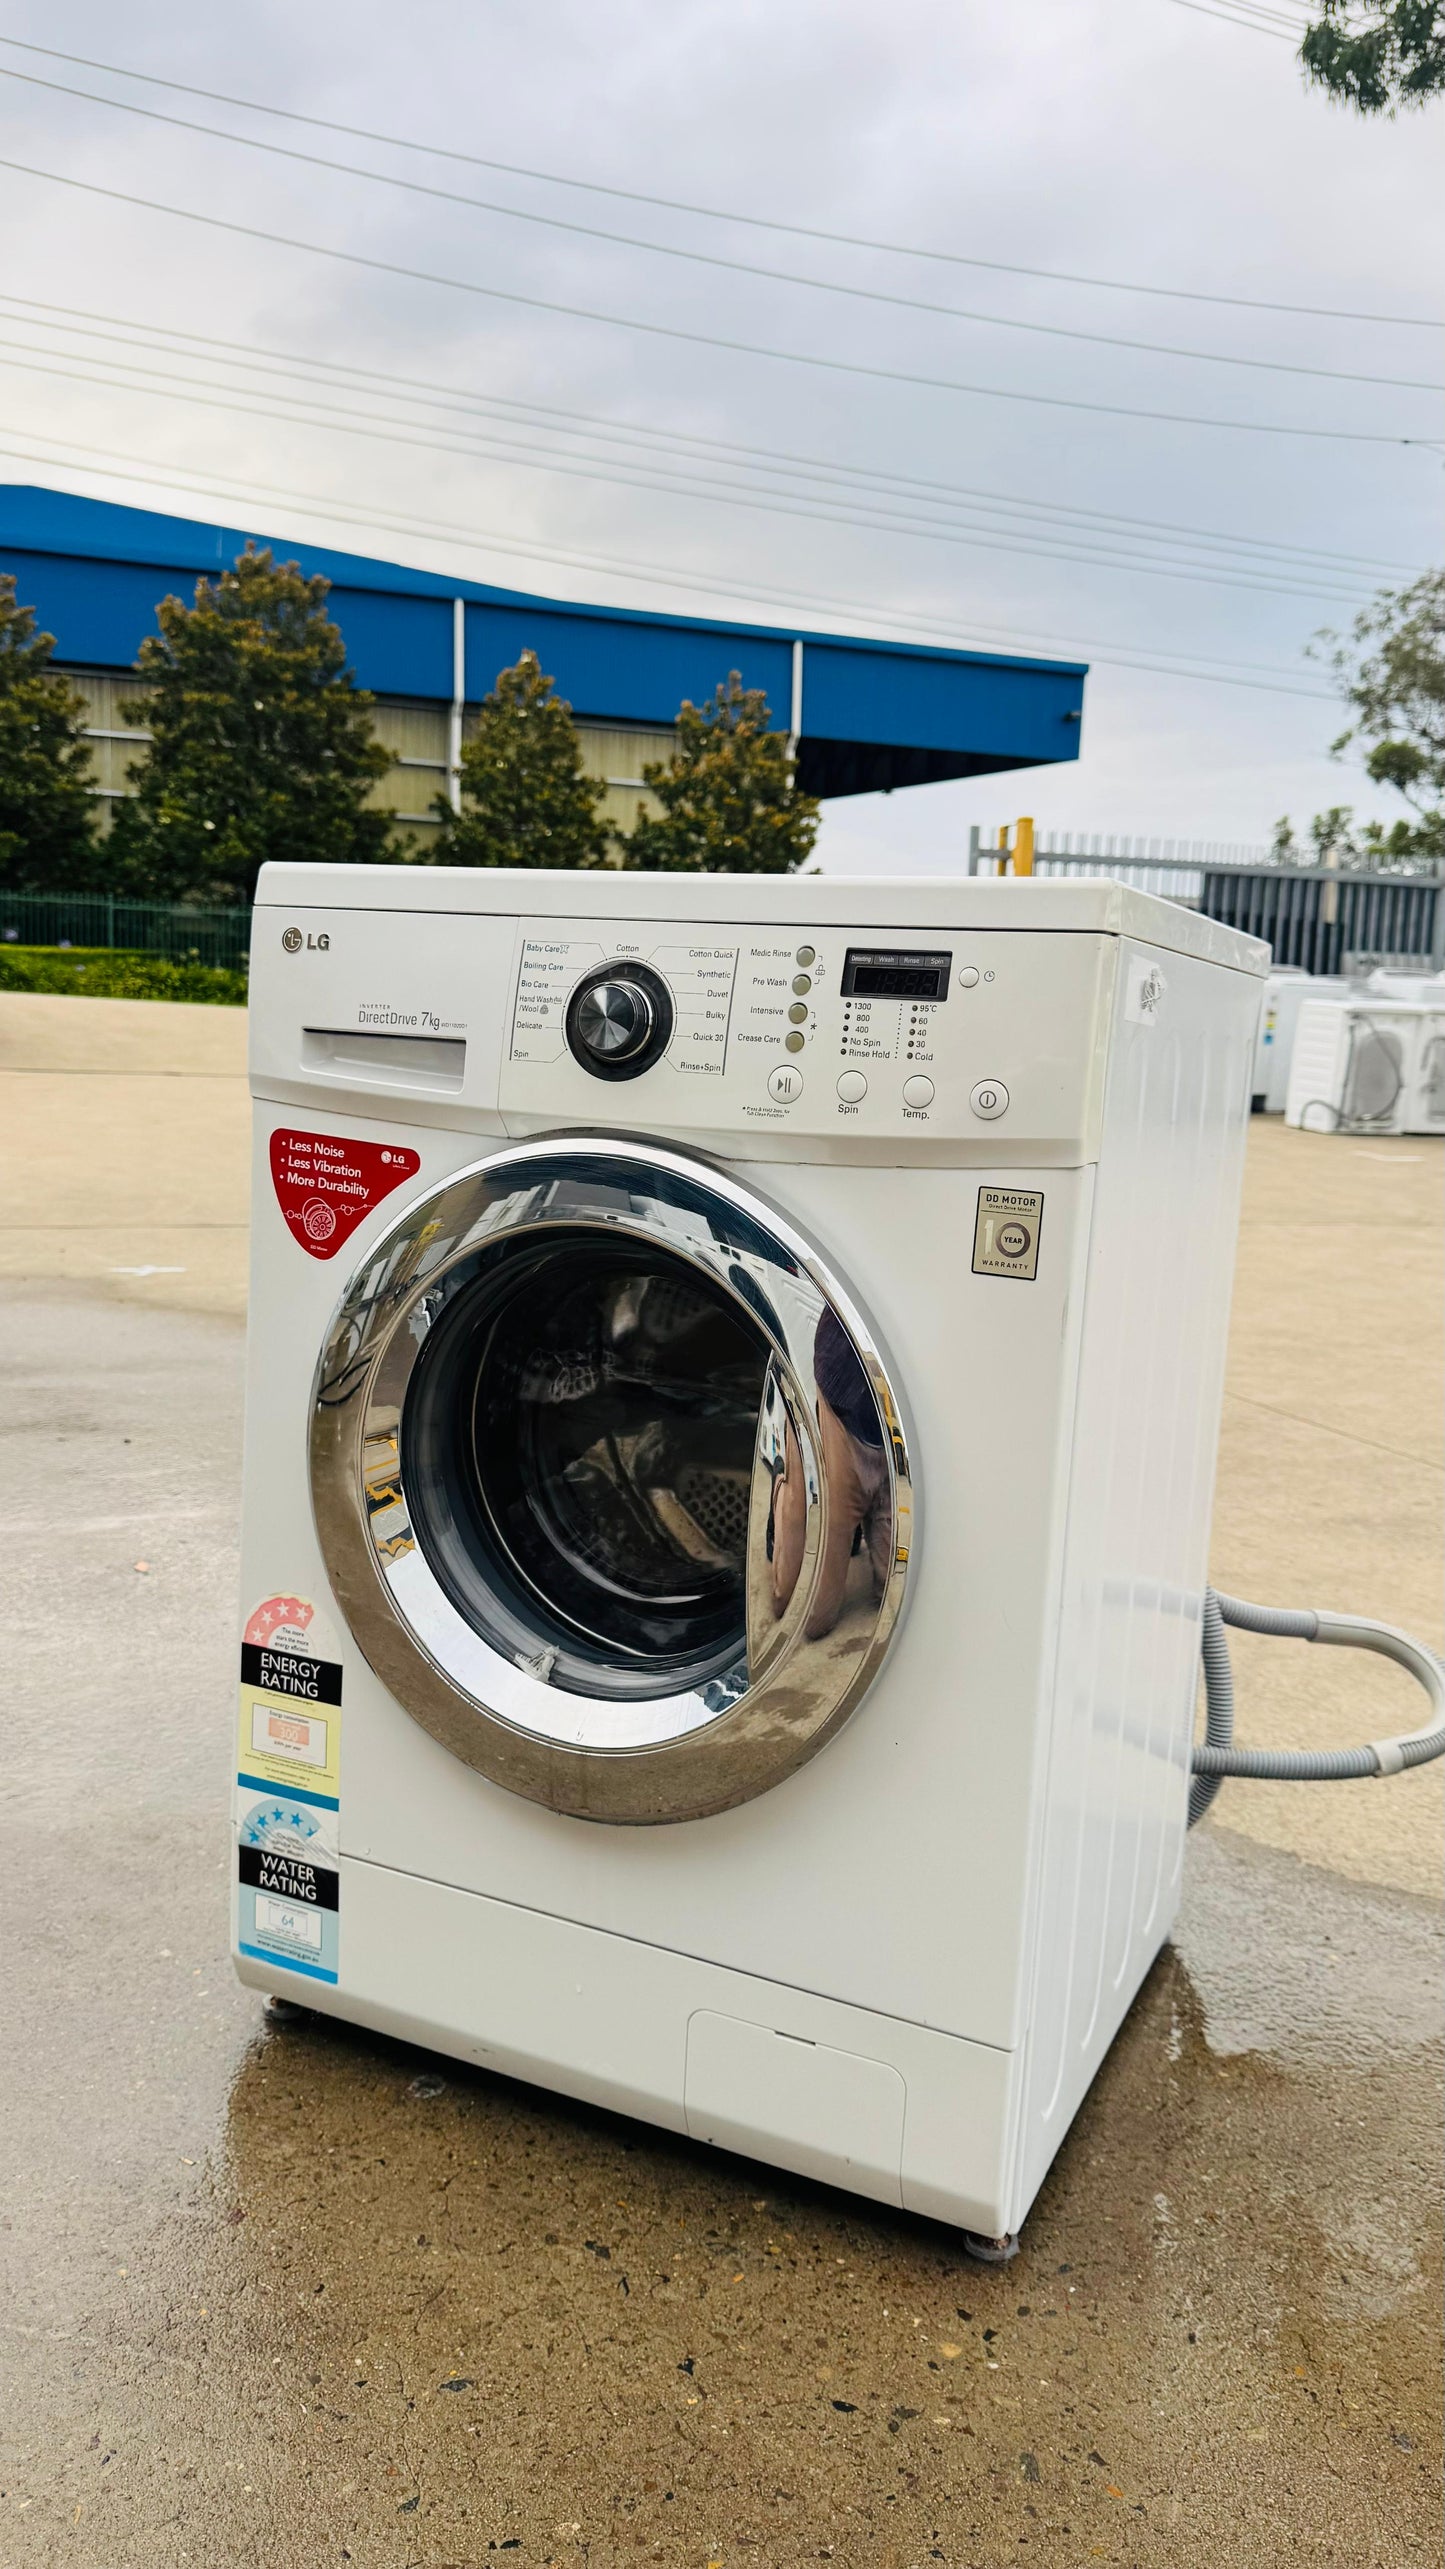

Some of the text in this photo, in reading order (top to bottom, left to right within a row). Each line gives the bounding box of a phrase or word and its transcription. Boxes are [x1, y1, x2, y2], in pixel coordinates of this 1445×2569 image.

[306, 933, 331, 951] LG
[526, 944, 560, 953] Baby Care
[616, 944, 639, 952] Cotton
[689, 950, 734, 959] Cotton Quick
[750, 949, 792, 958] Medic Rinse
[523, 962, 564, 971] Boiling Care
[697, 970, 731, 979] Synthetic
[521, 980, 549, 989] Bio Care
[752, 977, 787, 987] Pre Wash
[519, 995, 535, 1003] Hand
[707, 990, 729, 998] Duvet
[518, 1005, 539, 1013] /Wool
[750, 1006, 784, 1015] Intensive
[705, 1011, 726, 1020] Bulky
[421, 1011, 440, 1031] 7kg
[516, 1021, 543, 1030] Delicate
[693, 1033, 724, 1042] Quick 30
[737, 1033, 781, 1043] Crease Care
[850, 1037, 881, 1047] No Spin
[513, 1050, 529, 1058] Spin
[849, 1049, 890, 1059] Rinse Hold
[914, 1053, 934, 1061] Cold
[680, 1062, 721, 1072] Rinse+Spin
[838, 1103, 859, 1115] Spin
[902, 1108, 930, 1120] Temp.
[289, 1138, 345, 1158] Less Noise
[392, 1155, 405, 1164] LG
[288, 1154, 362, 1178] Less Vibration
[287, 1171, 370, 1200] More Durability
[986, 1194, 1036, 1207] DD MOTOR
[1004, 1236, 1023, 1244] YEAR
[982, 1259, 1029, 1270] WARRANTY
[274, 1642, 290, 1650] energy
[261, 1652, 320, 1680] ENERGY
[261, 1670, 318, 1698] RATING
[280, 1727, 298, 1741] 300
[261, 1853, 316, 1884] WATER
[260, 1870, 317, 1900] RATING
[281, 1914, 294, 1928] 64
